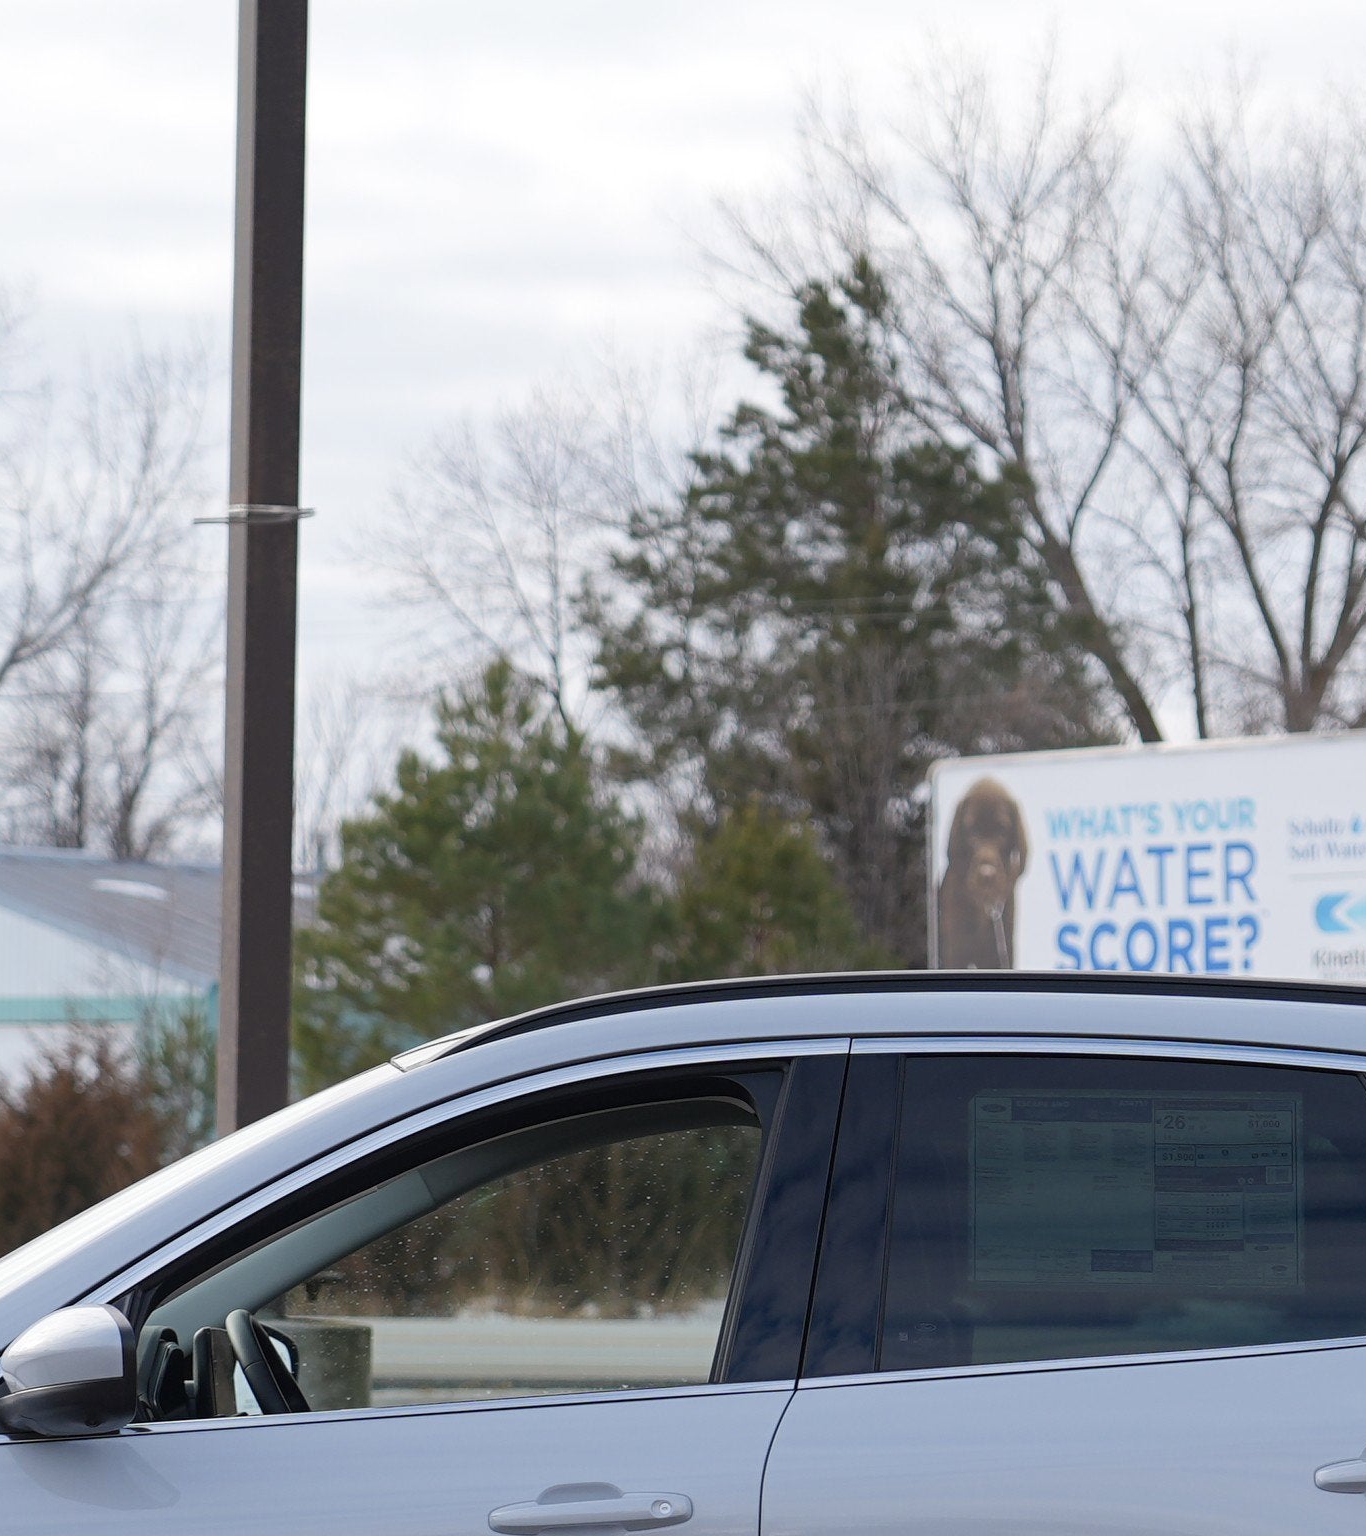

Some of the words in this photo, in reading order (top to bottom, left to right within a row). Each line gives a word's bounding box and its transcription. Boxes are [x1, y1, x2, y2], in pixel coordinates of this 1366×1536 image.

[1046, 803, 1163, 840] WHAT'S
[1173, 797, 1257, 832] YOUR
[1049, 840, 1259, 912] WATER
[1056, 913, 1260, 973] SCORE?
[1163, 1115, 1187, 1130] 26
